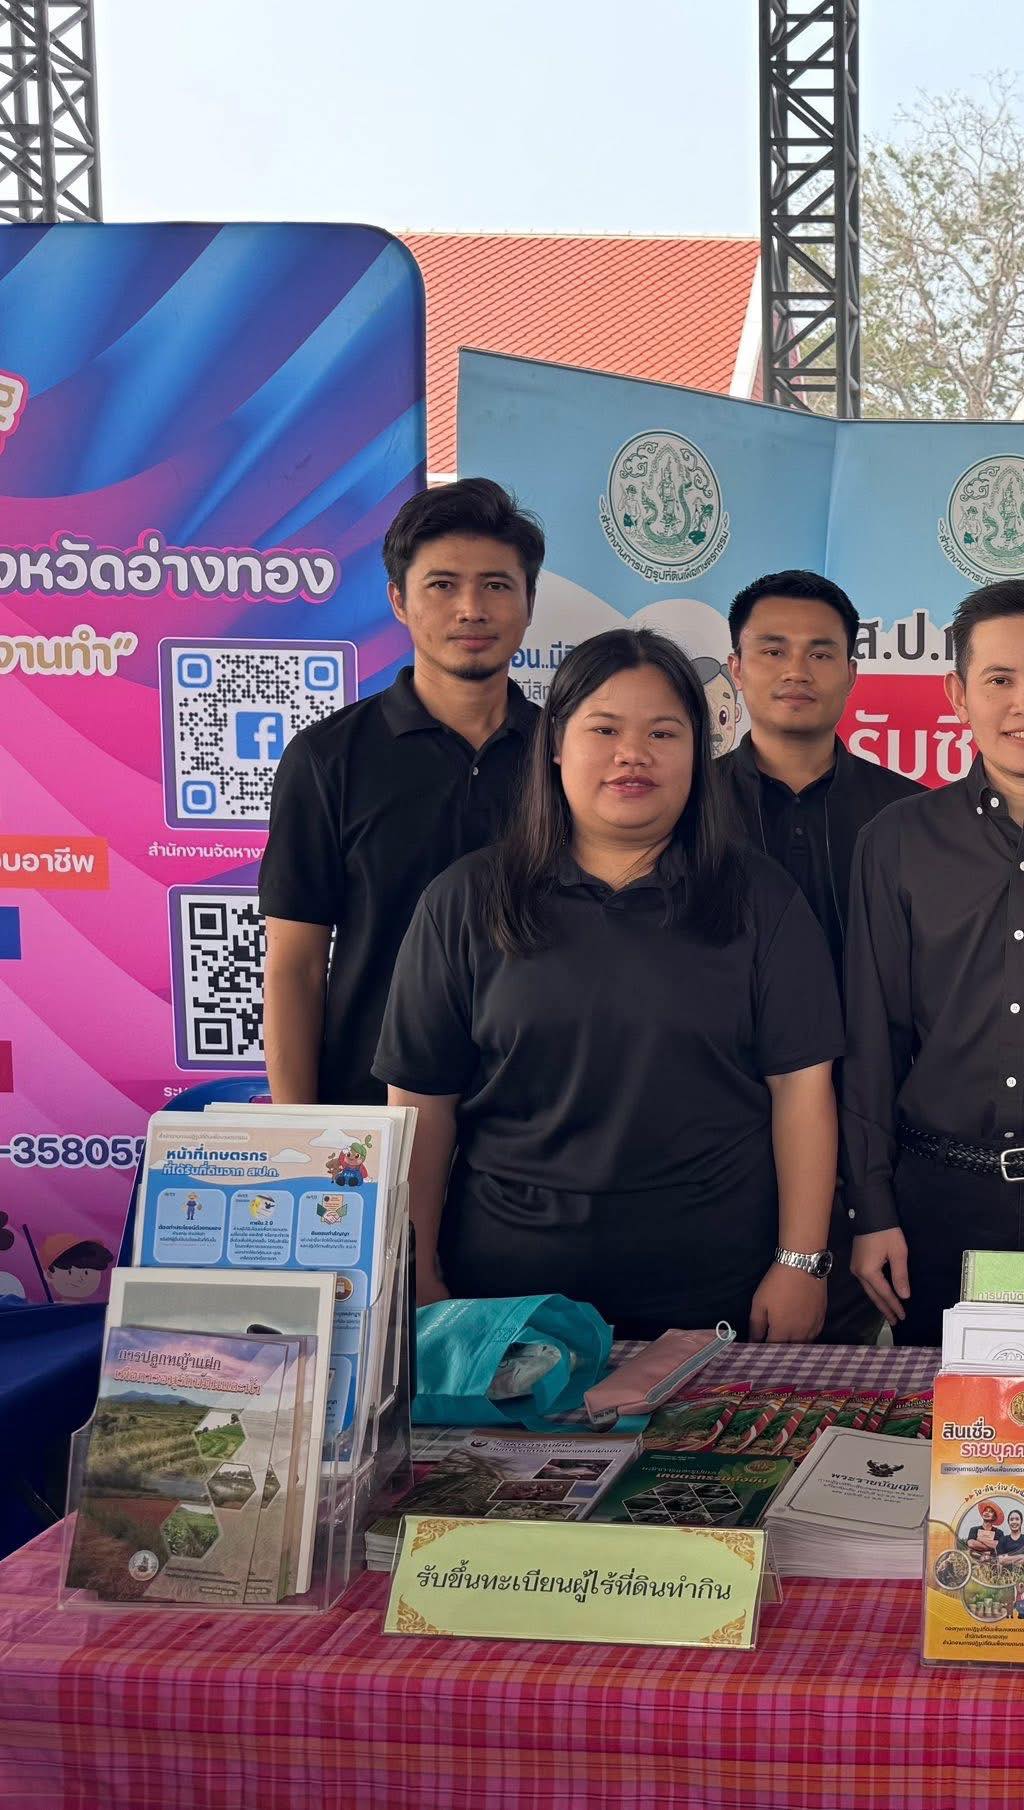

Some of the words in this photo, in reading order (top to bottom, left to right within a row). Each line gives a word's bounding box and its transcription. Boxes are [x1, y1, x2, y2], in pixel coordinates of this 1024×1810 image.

[0, 846, 95, 874] บอาชีพ
[166, 1143, 268, 1161] หน้าที่เกษตรกร
[943, 1416, 995, 1440] สินเชื่อ
[416, 1559, 732, 1604] รับขึ้นทะเบียนผู้ไร้ที่ดินทำกิน
